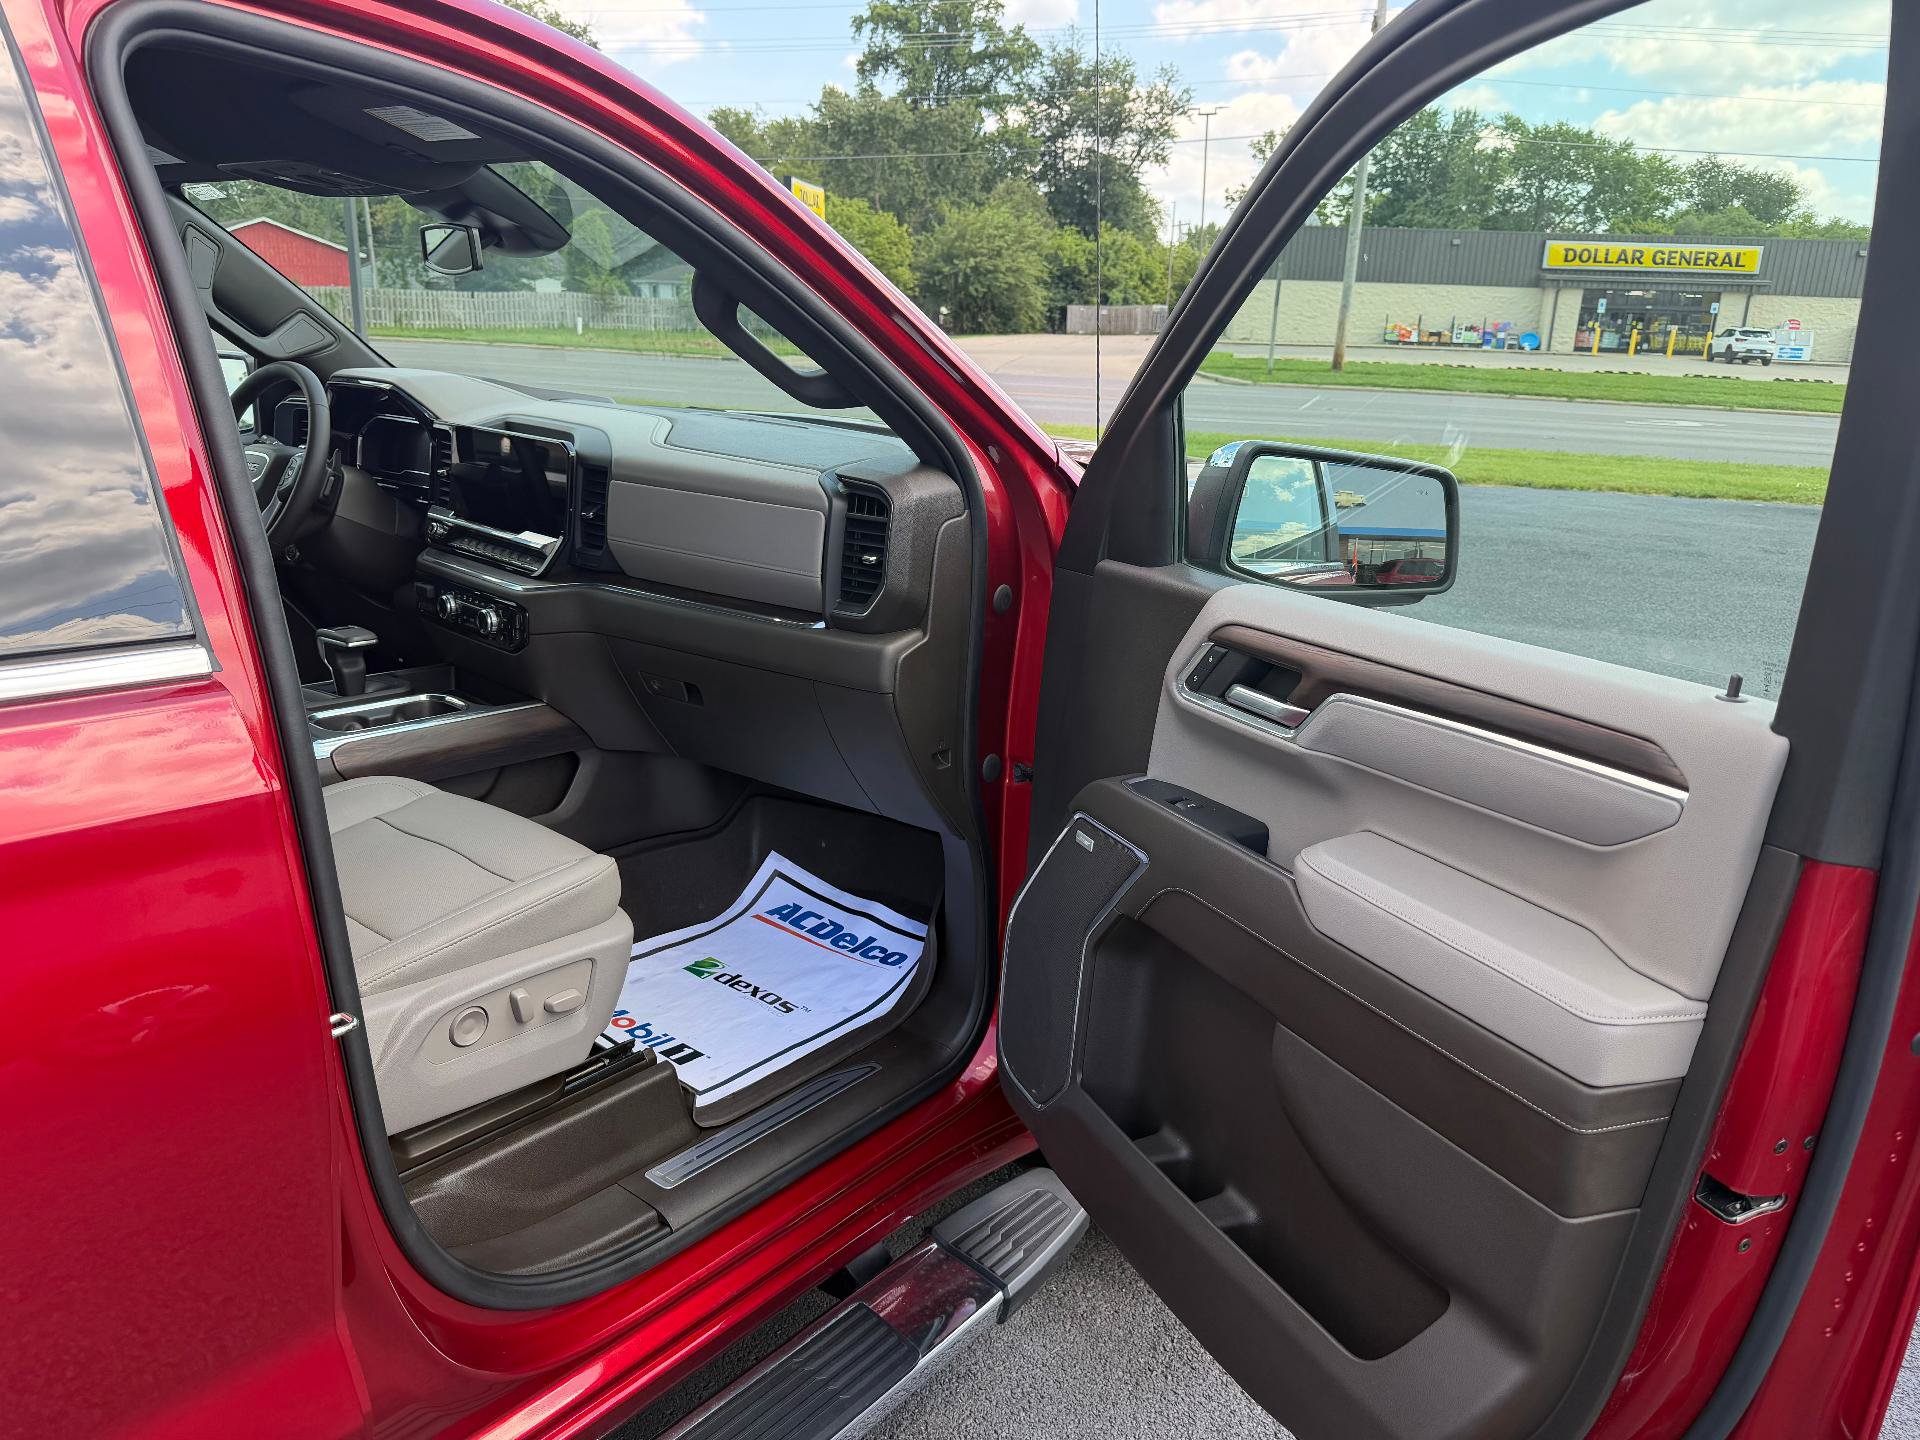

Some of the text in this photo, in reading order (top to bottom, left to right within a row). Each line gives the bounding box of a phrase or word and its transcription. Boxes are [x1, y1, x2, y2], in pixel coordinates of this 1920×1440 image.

[1563, 247, 1746, 268] DOLLAR GENERAL
[764, 902, 909, 967] ACDelco
[713, 970, 800, 1014] dexos
